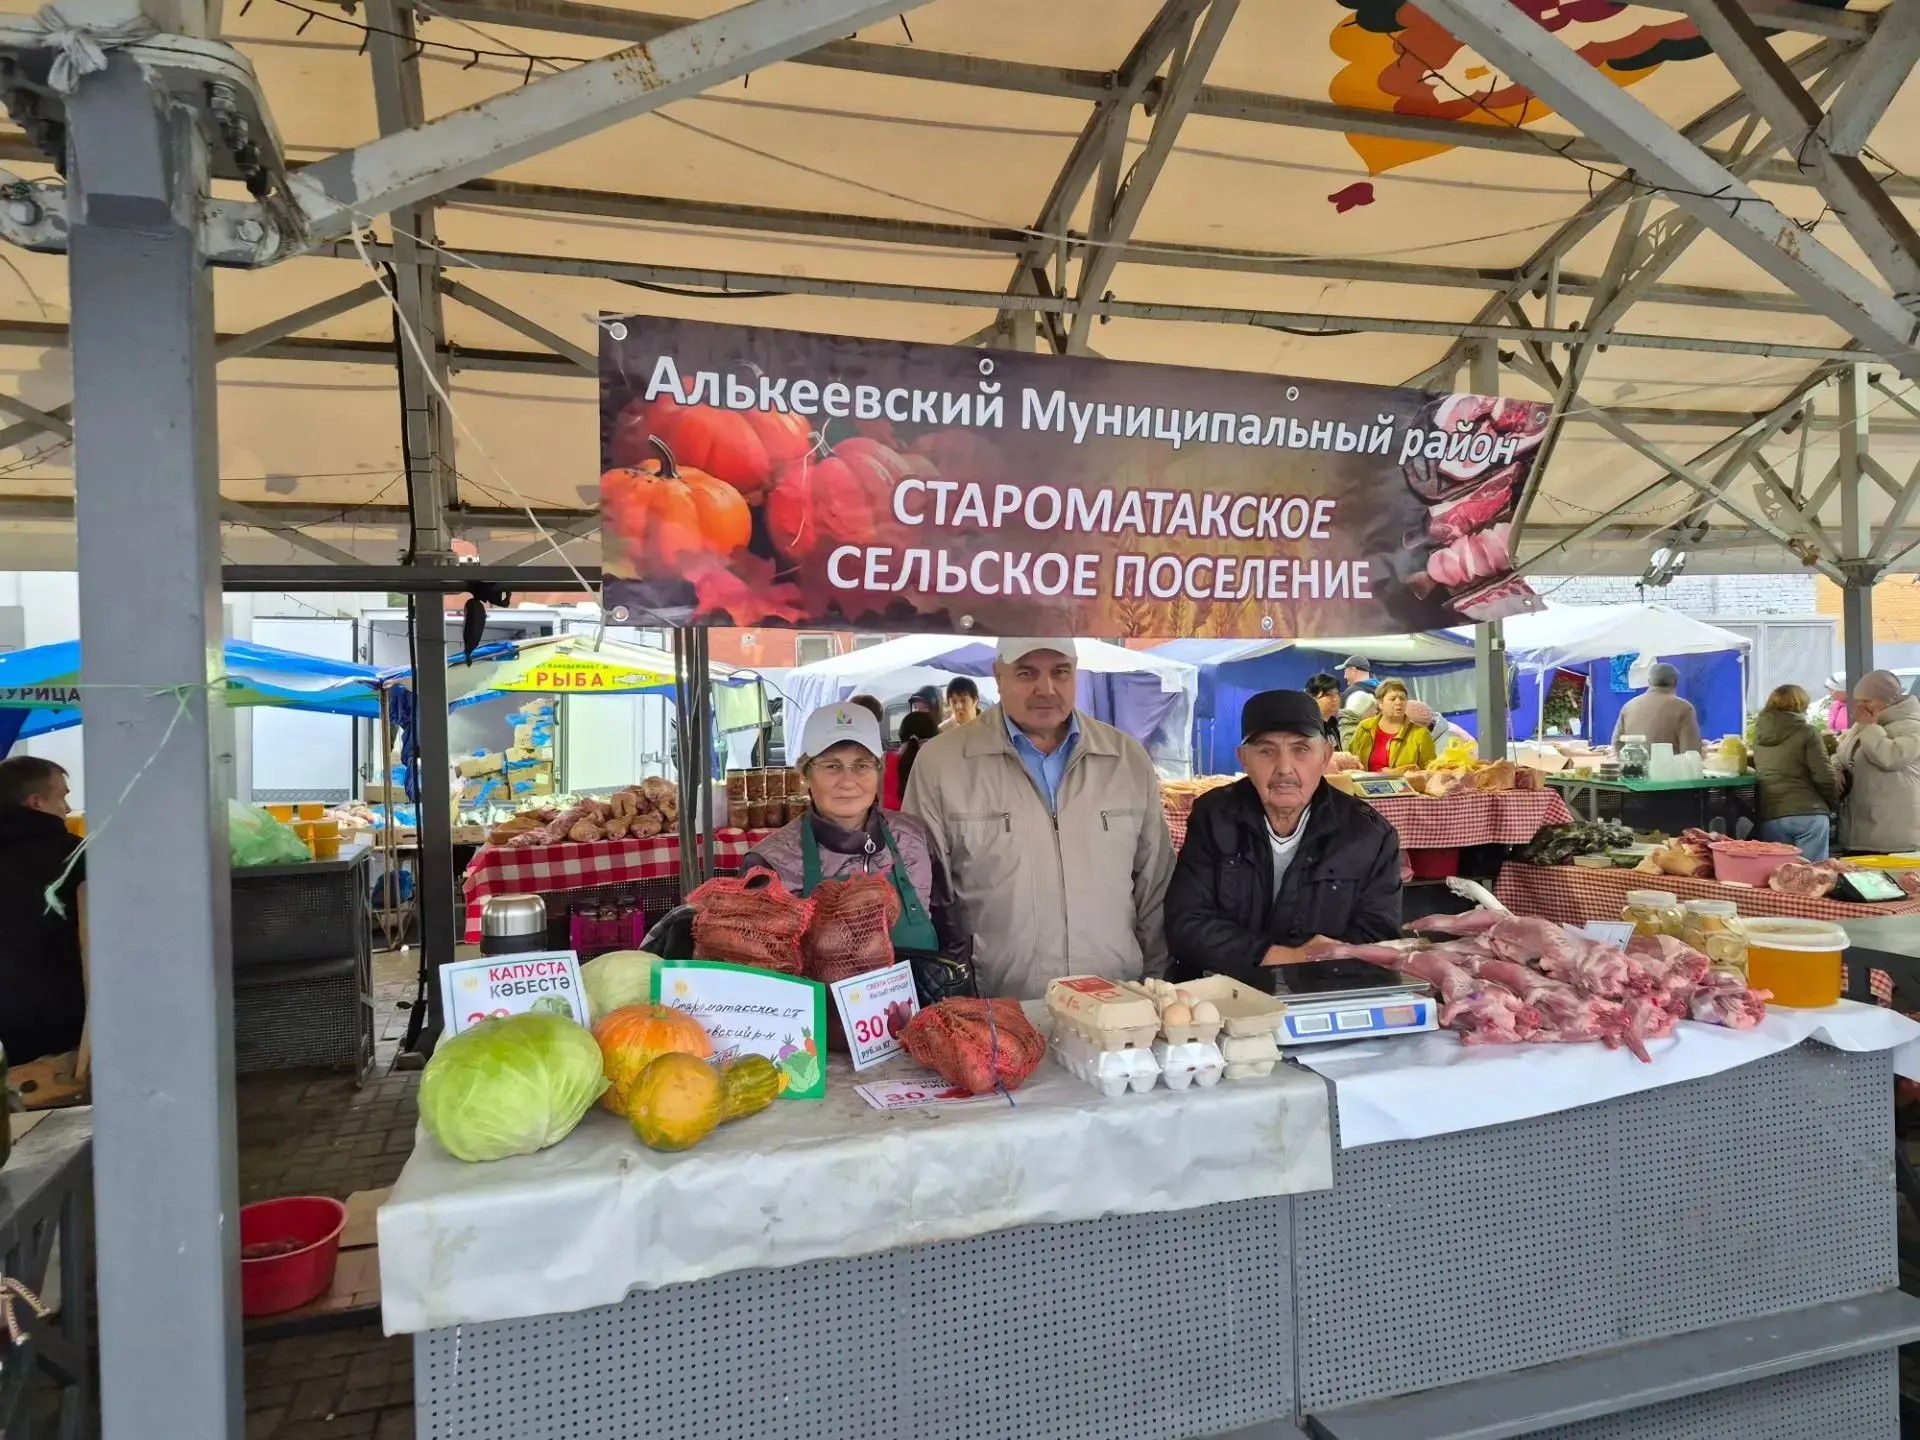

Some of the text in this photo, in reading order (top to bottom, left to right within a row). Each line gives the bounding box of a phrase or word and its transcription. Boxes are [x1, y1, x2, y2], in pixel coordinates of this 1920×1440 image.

[645, 355, 1519, 466] Алькеевский Муниципальный район
[893, 479, 1336, 540] СТАРОМАТАКСКОЕ
[826, 544, 1373, 599] СЕЛЬСКОЕ ПОСЕЛЕНИЕ
[536, 671, 604, 687] РЫБА
[0, 687, 81, 704] УРИЦА
[489, 961, 568, 982] КАПУСТА
[490, 977, 571, 999] КӘБЕСТӘ
[855, 1015, 884, 1043] 30
